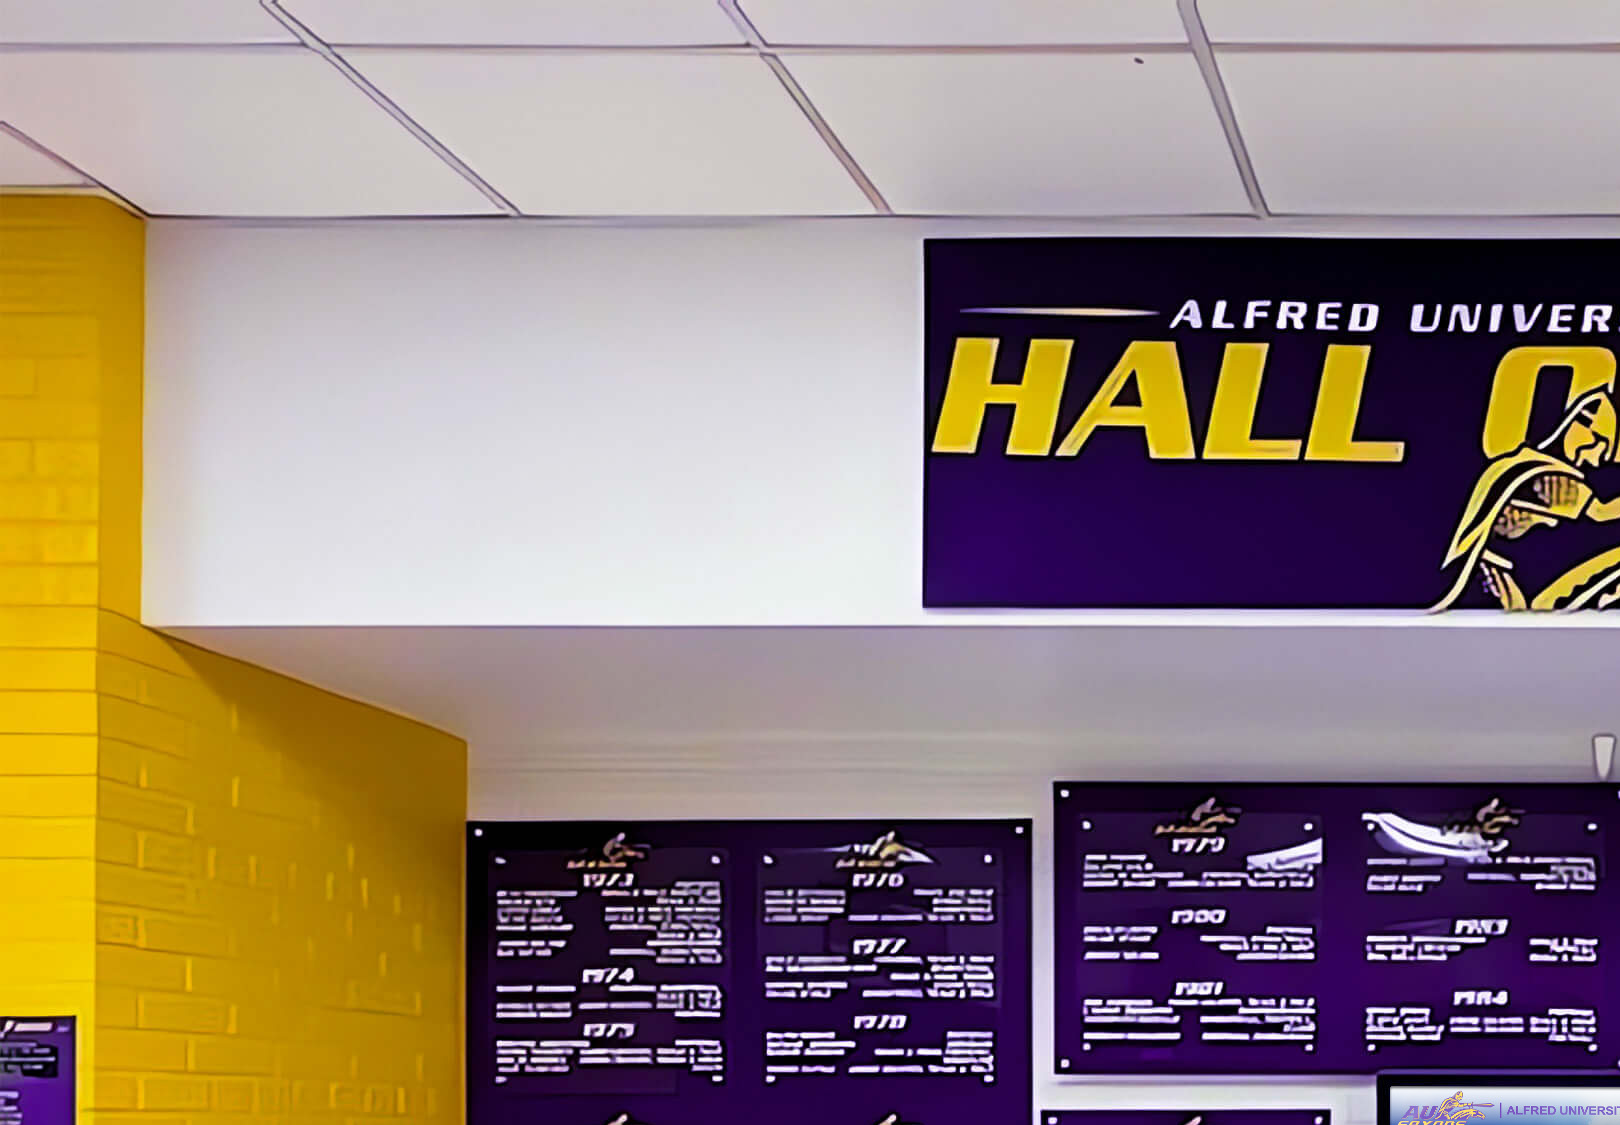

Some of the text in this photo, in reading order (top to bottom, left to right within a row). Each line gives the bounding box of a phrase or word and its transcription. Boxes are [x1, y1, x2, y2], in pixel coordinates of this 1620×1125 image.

[1167, 298, 1381, 332] ALFRED
[931, 337, 1403, 462] HALL
[1401, 1105, 1438, 1120] AU
[1506, 1105, 1557, 1115] ALFRED
